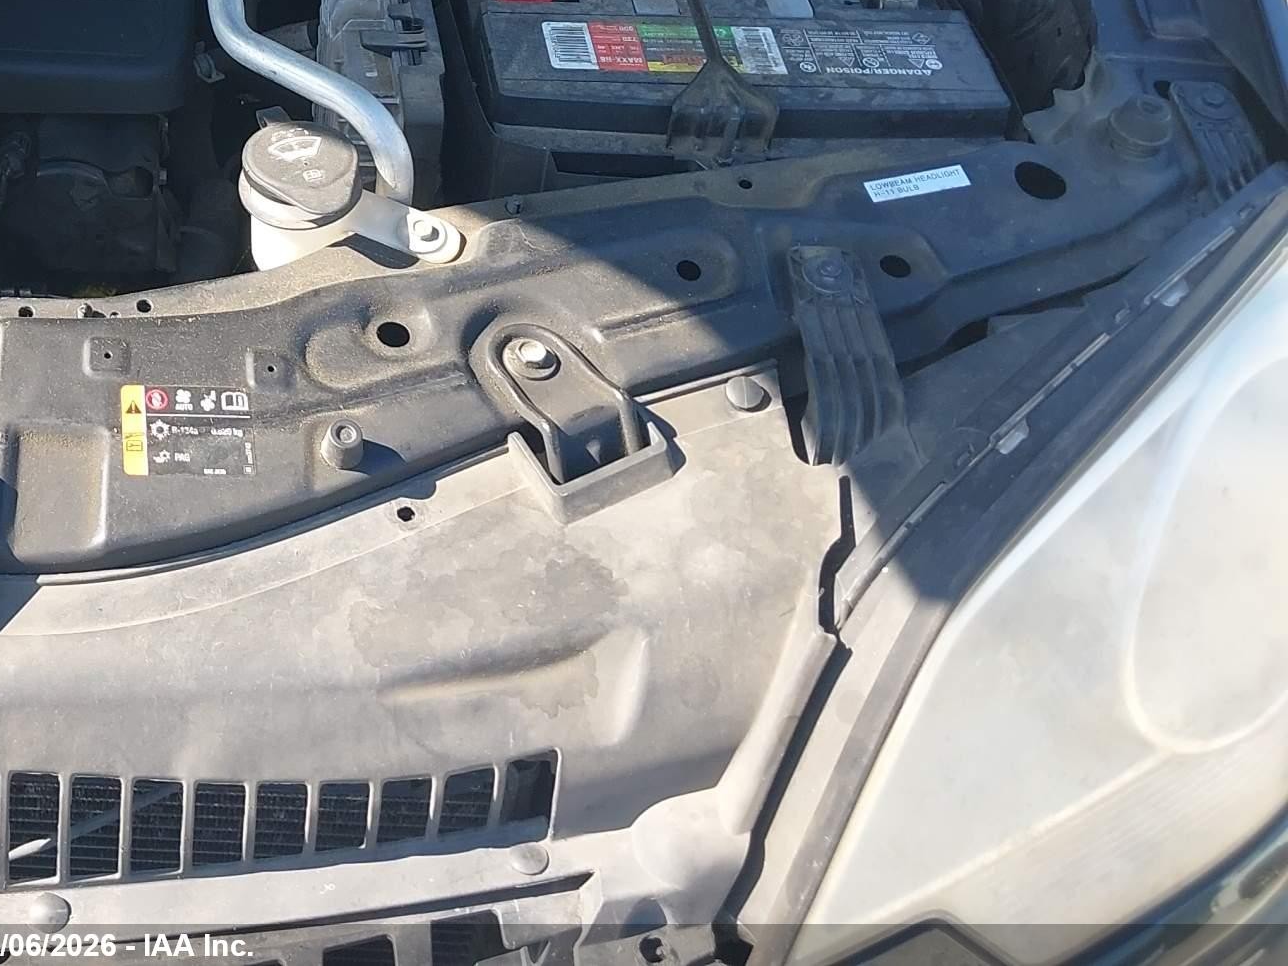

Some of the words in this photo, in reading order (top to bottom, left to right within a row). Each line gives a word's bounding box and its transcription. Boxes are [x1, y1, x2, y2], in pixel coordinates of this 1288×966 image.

[869, 177, 913, 191] LOWBEAM
[914, 169, 960, 183] HEADLIGHT
[873, 188, 895, 198] H-11
[898, 185, 920, 194] BULB
[175, 403, 193, 411] AUTO
